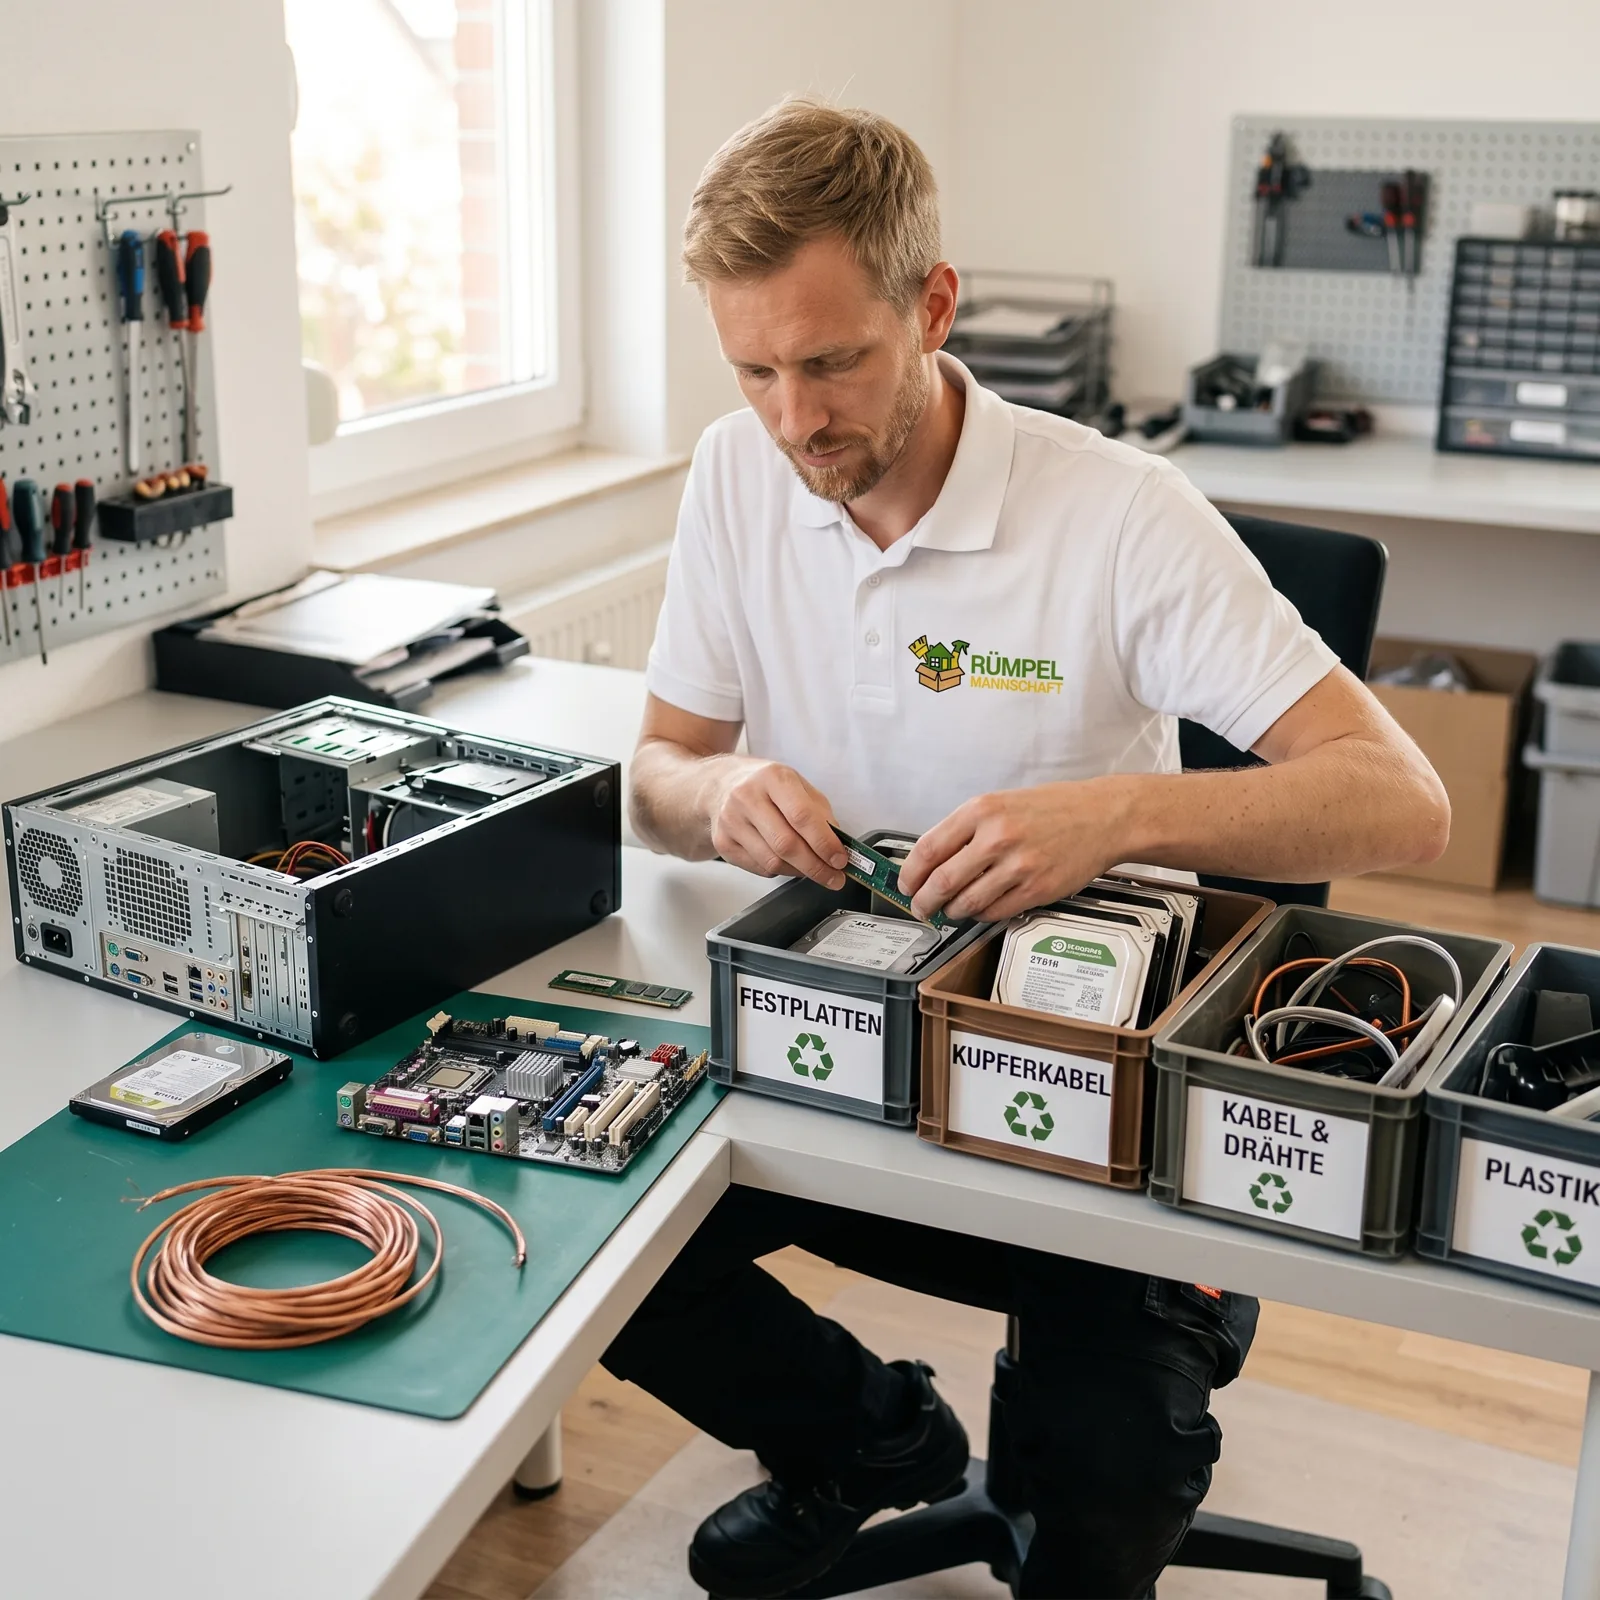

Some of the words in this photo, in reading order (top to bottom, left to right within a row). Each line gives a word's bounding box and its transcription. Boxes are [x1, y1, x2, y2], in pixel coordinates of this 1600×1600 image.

[970, 676, 1064, 695] MANNSCHAFT
[971, 651, 1064, 681] RÜMPEL
[740, 986, 883, 1037] FESTPLATTEN
[952, 1043, 1112, 1097] KUPFERKABEL
[1222, 1100, 1303, 1138] KABEL
[1310, 1119, 1330, 1144] &
[1224, 1133, 1325, 1176] DRÄHTE
[1485, 1157, 1600, 1207] PLASTIK
